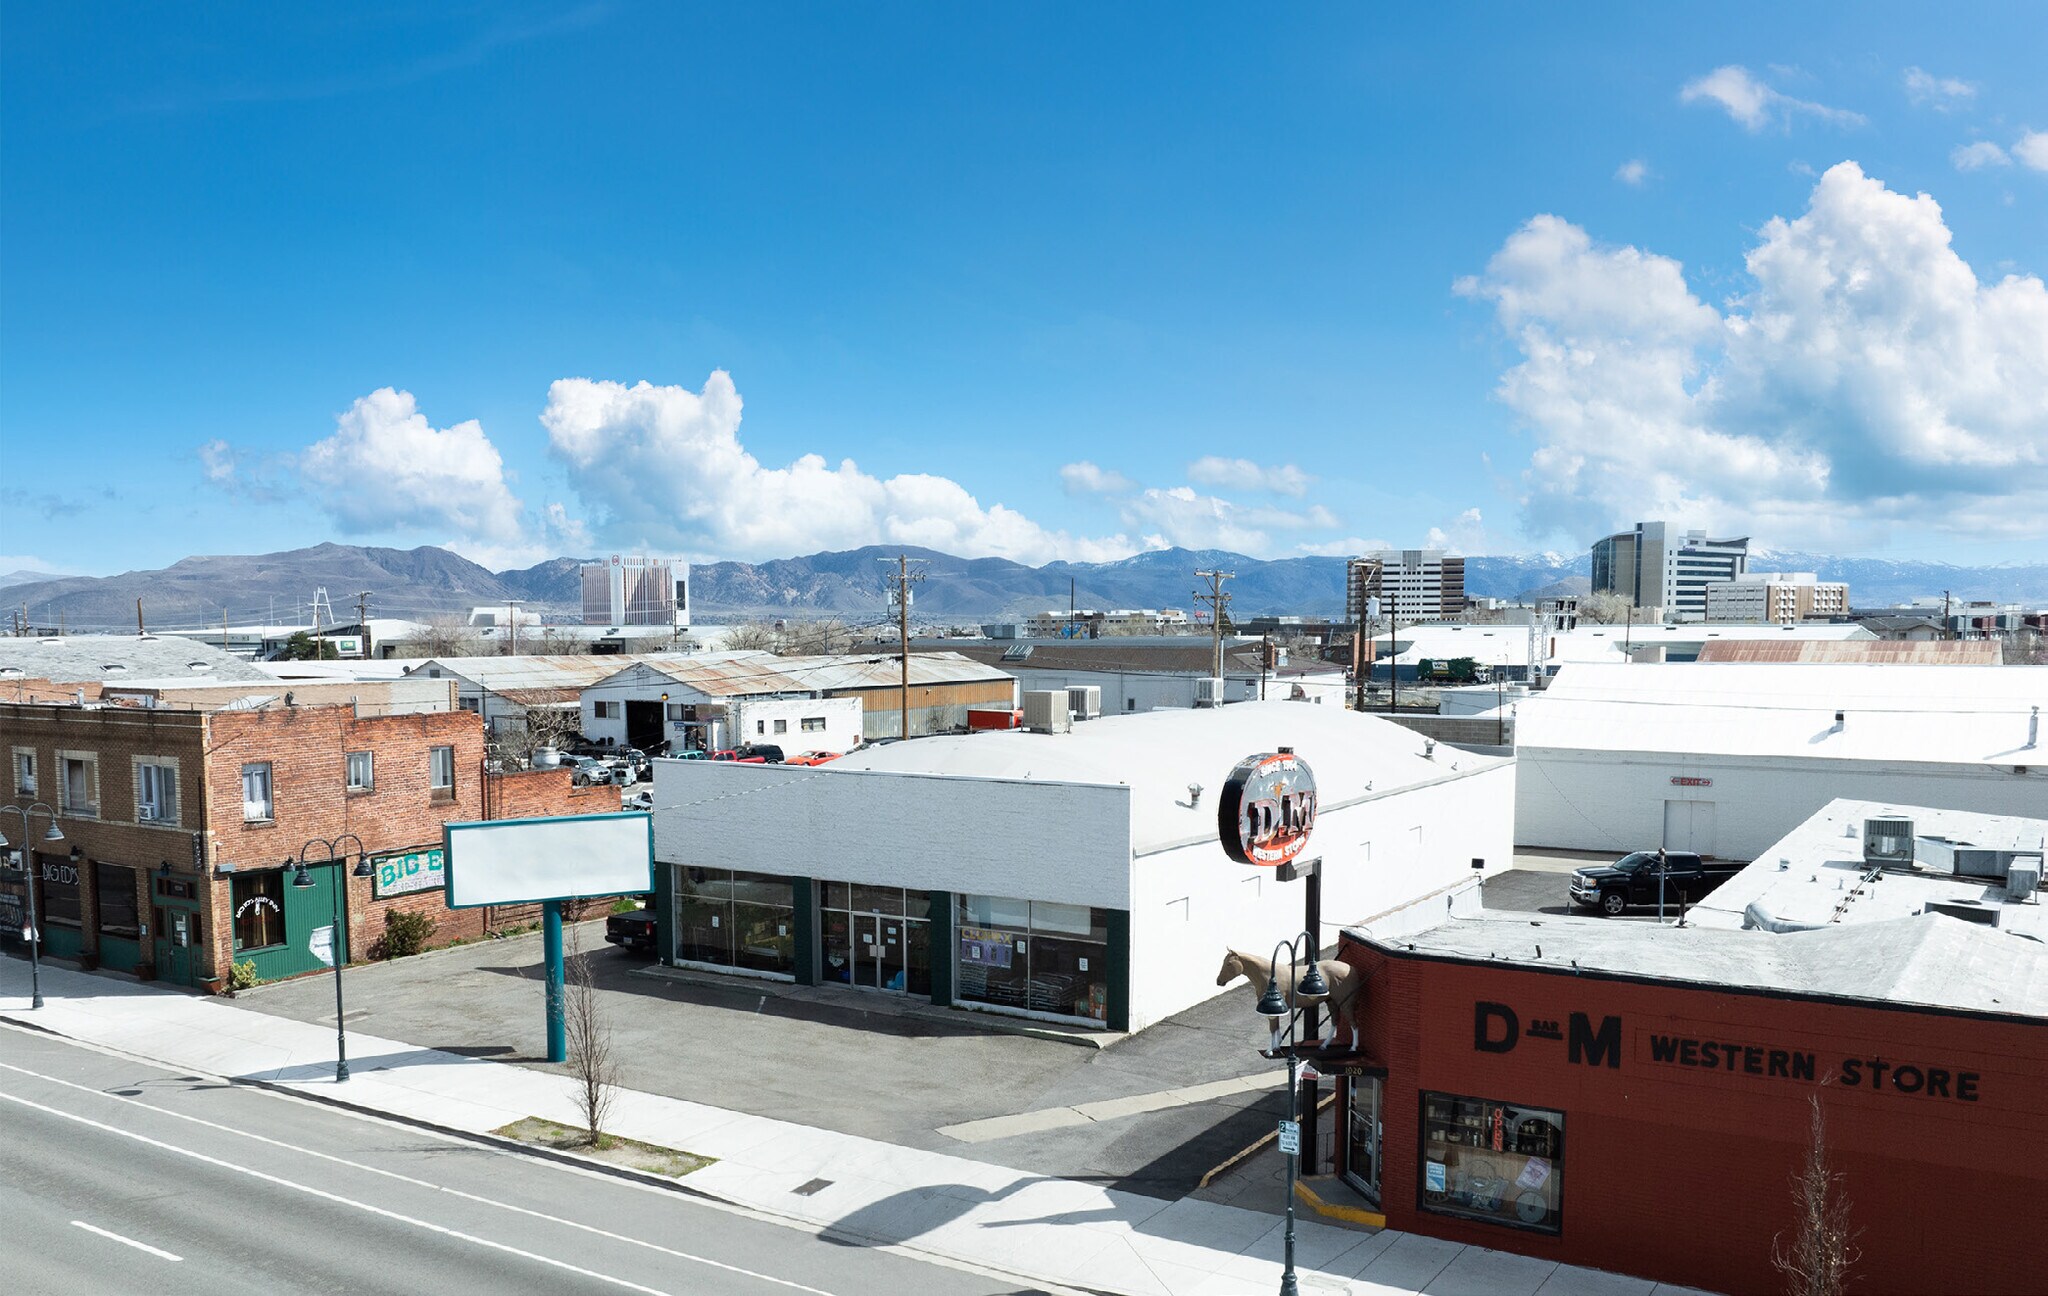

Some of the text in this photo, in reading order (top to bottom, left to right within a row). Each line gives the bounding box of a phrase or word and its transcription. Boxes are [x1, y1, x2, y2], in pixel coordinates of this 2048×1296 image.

[1260, 760, 1281, 777] SINCE
[1680, 777, 1701, 786] EXIT
[1247, 791, 1314, 845] D M
[42, 862, 79, 886] BIG ED'S
[1474, 1001, 1980, 1102] D BAR M WESTERN STORE
[1493, 1107, 1503, 1152] OPEN
